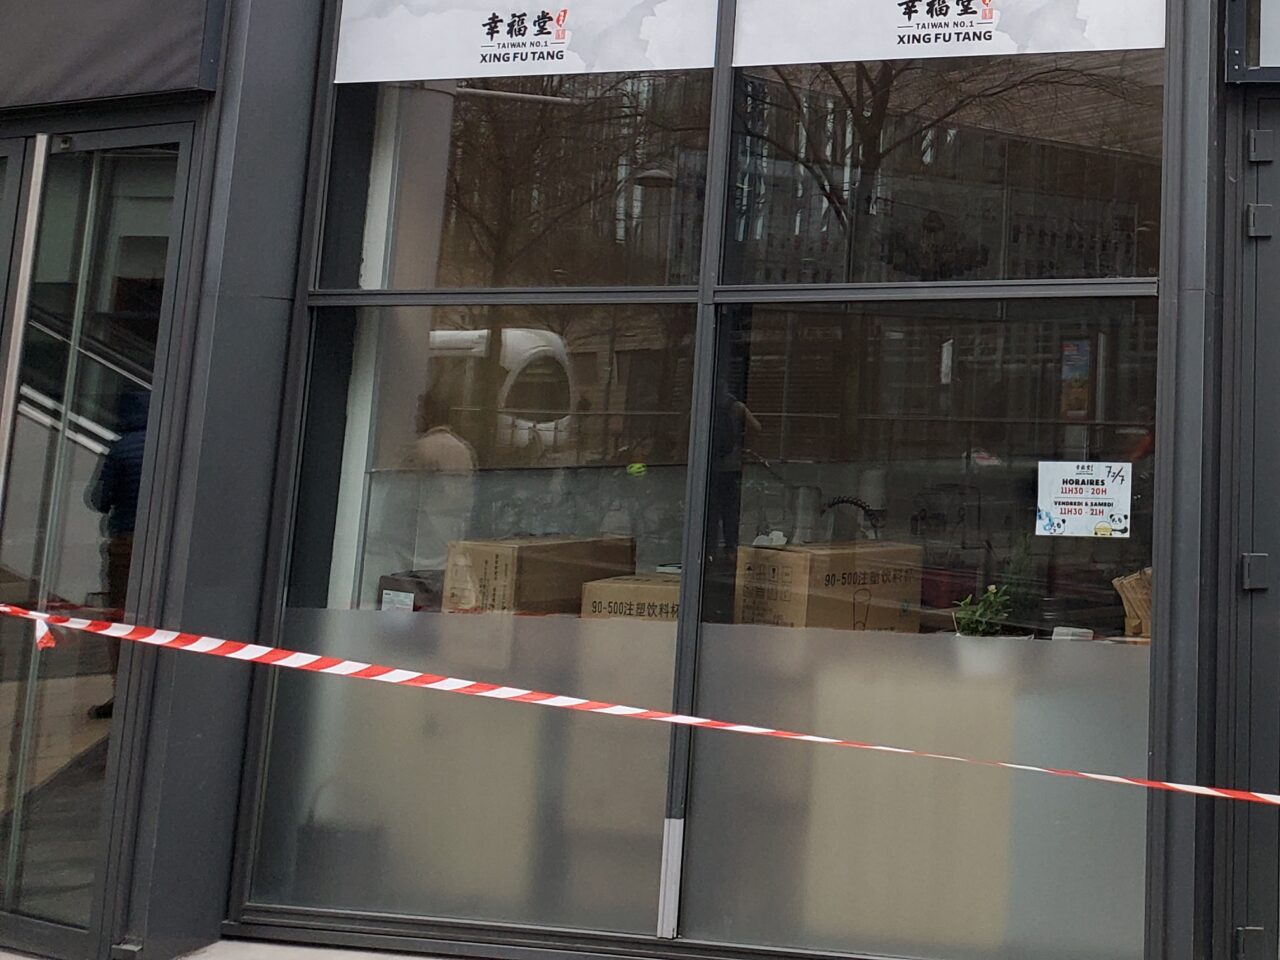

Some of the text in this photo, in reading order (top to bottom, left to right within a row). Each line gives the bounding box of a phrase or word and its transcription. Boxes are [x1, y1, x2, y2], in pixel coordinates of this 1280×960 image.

[481, 10, 554, 42] 幸福堂
[916, 20, 975, 30] TAIWAN NO.1
[897, 30, 993, 45] XING FU TANG
[497, 40, 548, 49] TAIWAN NO.1
[480, 50, 565, 64] XING FU TANG
[1062, 478, 1106, 486] HORAIRES
[1060, 486, 1084, 495] 11H30
[1090, 487, 1107, 495] 20H
[1059, 507, 1083, 516] 11H30
[1090, 508, 1104, 516] 21H
